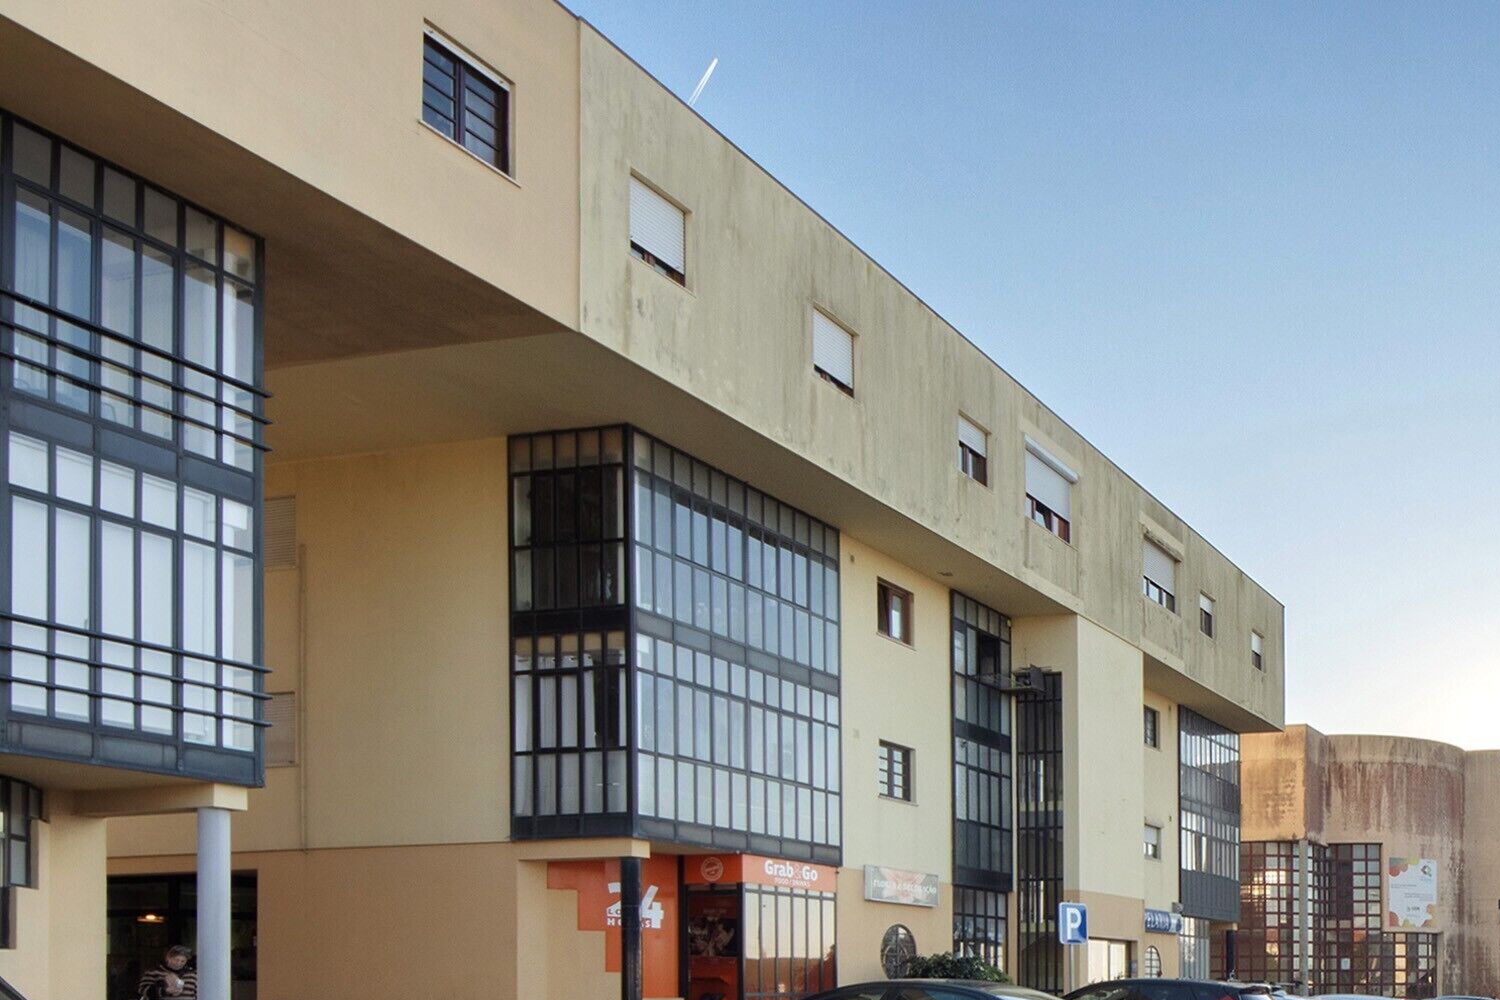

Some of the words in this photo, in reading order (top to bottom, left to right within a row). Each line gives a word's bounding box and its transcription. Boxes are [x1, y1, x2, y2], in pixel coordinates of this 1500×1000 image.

[764, 860, 794, 878] Grab
[802, 865, 818, 881] Go
[1066, 907, 1082, 940] P
